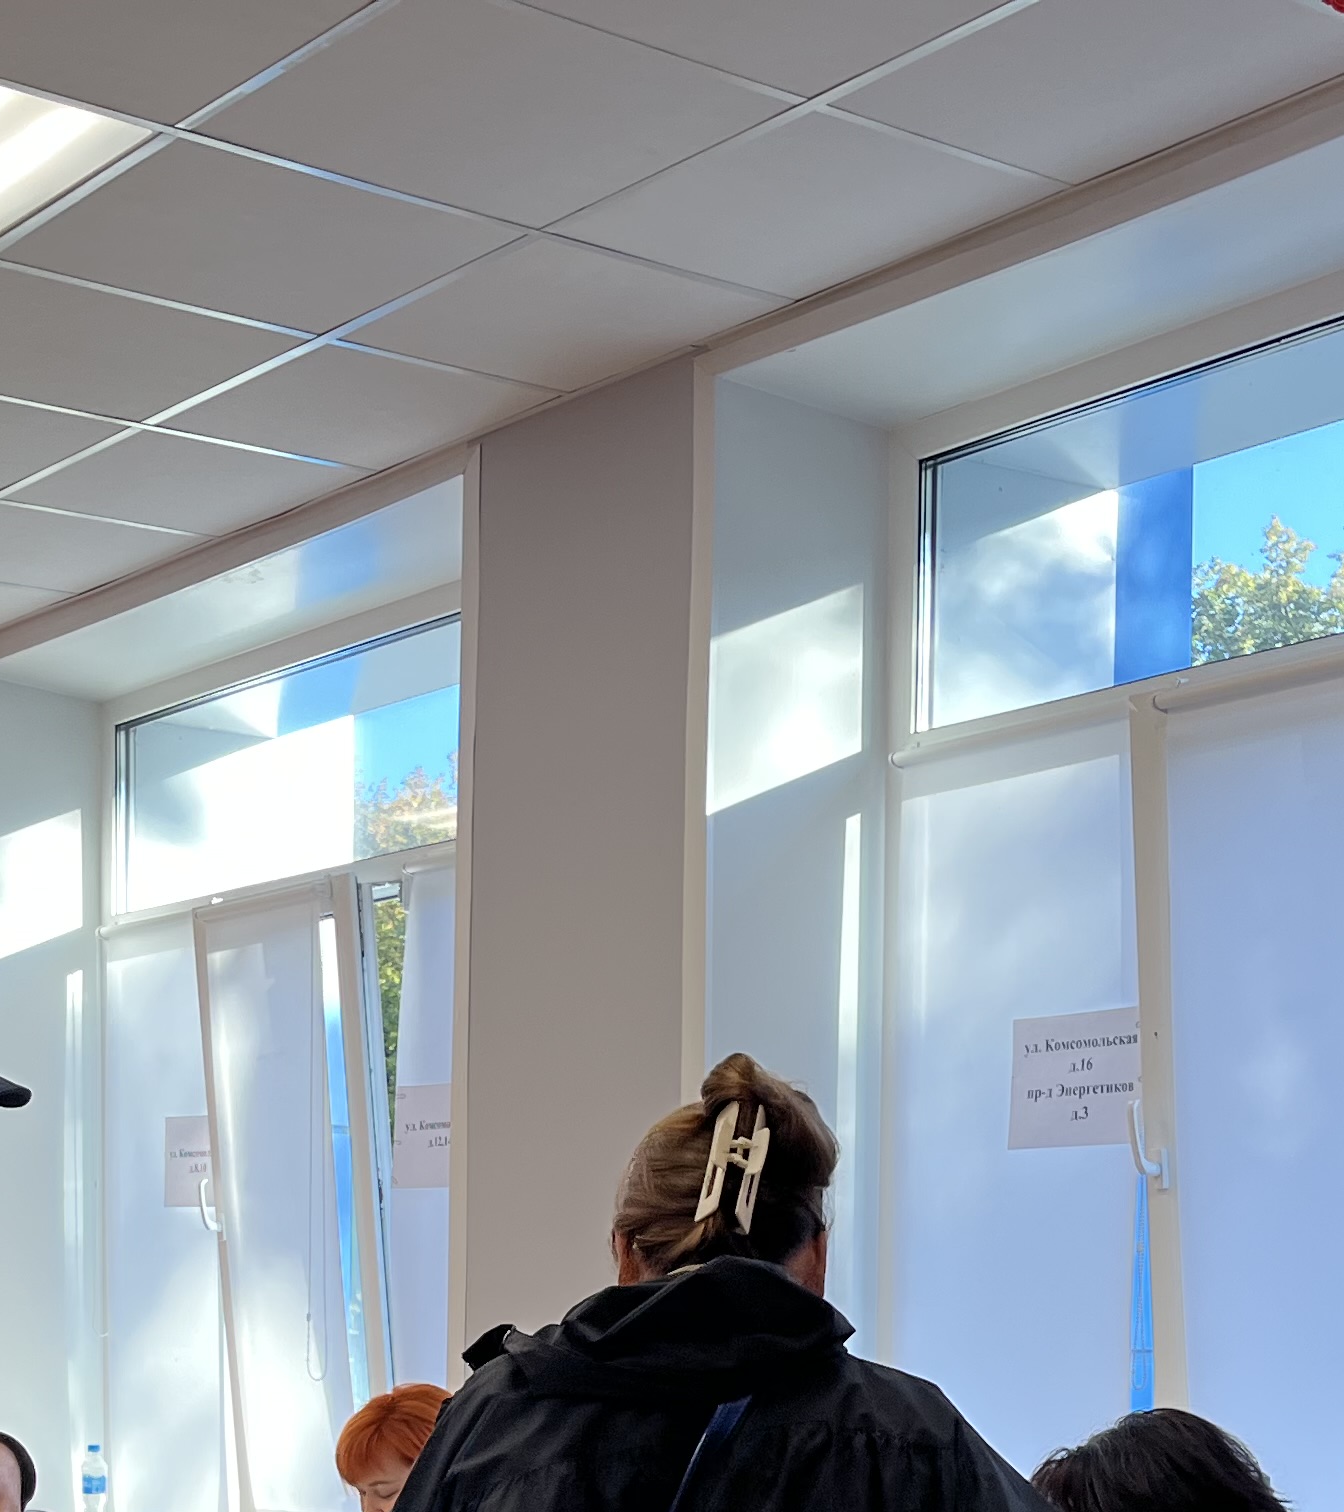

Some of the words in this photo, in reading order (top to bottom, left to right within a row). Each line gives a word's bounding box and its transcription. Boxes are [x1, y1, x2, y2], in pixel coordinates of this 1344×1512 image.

[1023, 1043, 1043, 1059] ул.
[1045, 1033, 1139, 1053] Комсомольская
[1068, 1057, 1093, 1074] д.16
[1027, 1087, 1053, 1102] пр-д
[1056, 1081, 1135, 1100] Энергетиков
[1070, 1105, 1089, 1121] д.3
